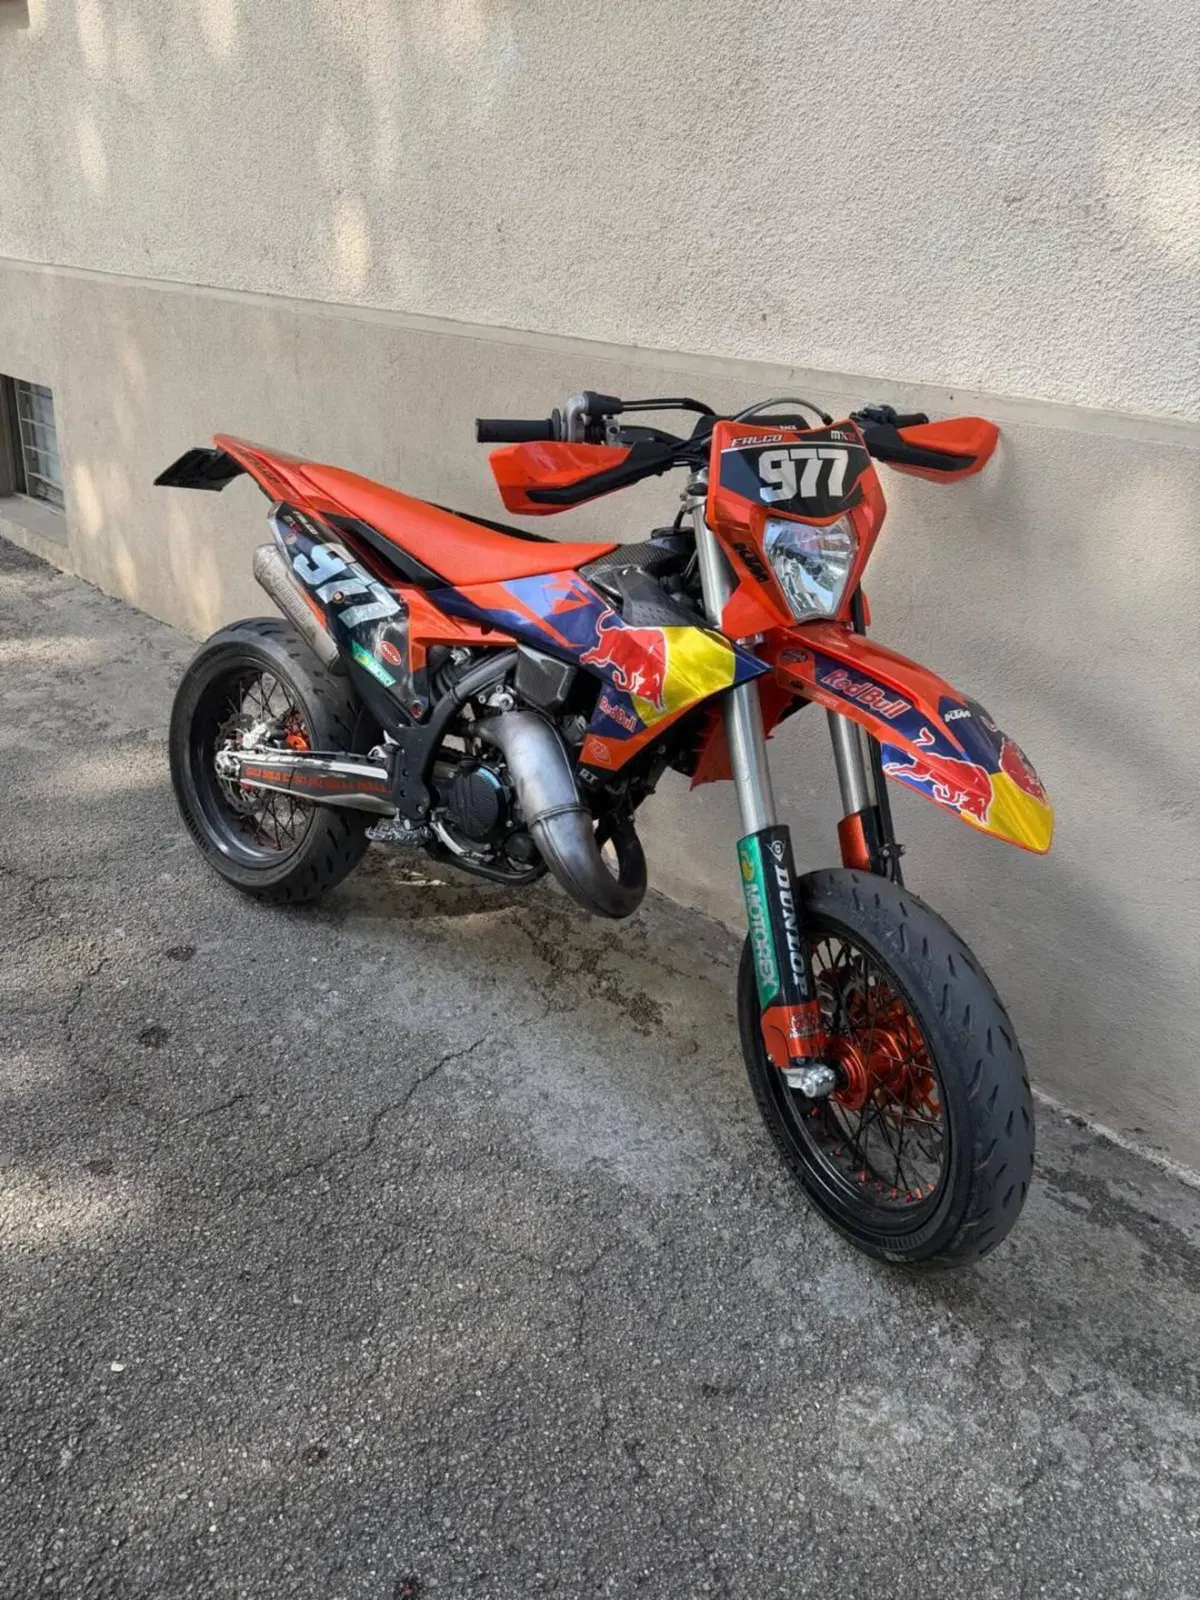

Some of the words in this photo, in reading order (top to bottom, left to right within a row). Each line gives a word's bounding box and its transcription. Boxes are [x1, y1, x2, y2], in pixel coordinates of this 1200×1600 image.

[731, 434, 782, 447] FALCO
[759, 448, 848, 502] 977
[293, 543, 401, 628] 977
[944, 707, 971, 723] KTM
[746, 884, 776, 986] MOTOREX
[775, 865, 808, 996] DUNLOP
